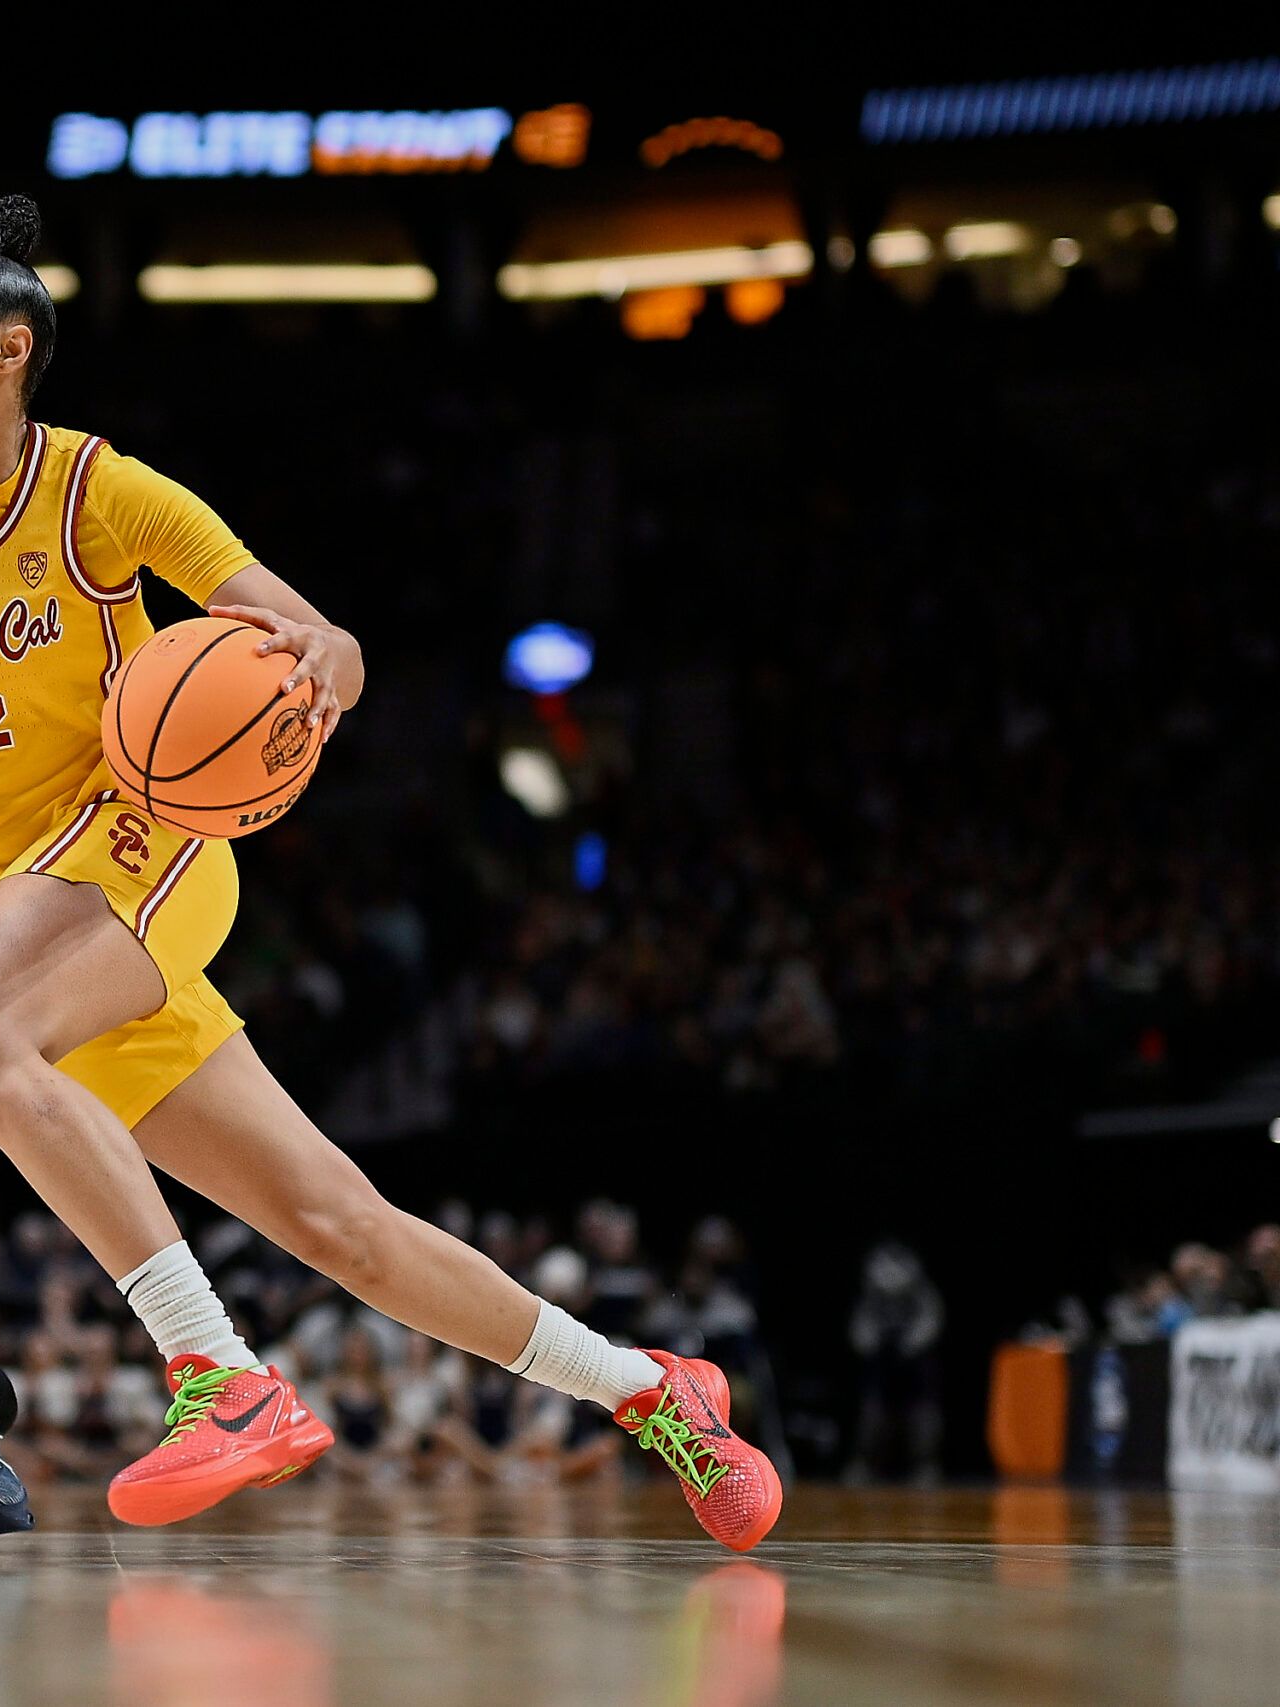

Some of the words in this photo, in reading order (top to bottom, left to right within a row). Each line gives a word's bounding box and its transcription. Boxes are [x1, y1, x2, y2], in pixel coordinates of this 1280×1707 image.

[20, 553, 47, 572] PAC
[25, 566, 40, 580] 12
[262, 725, 303, 763] MADNESS
[107, 811, 151, 875] SC
